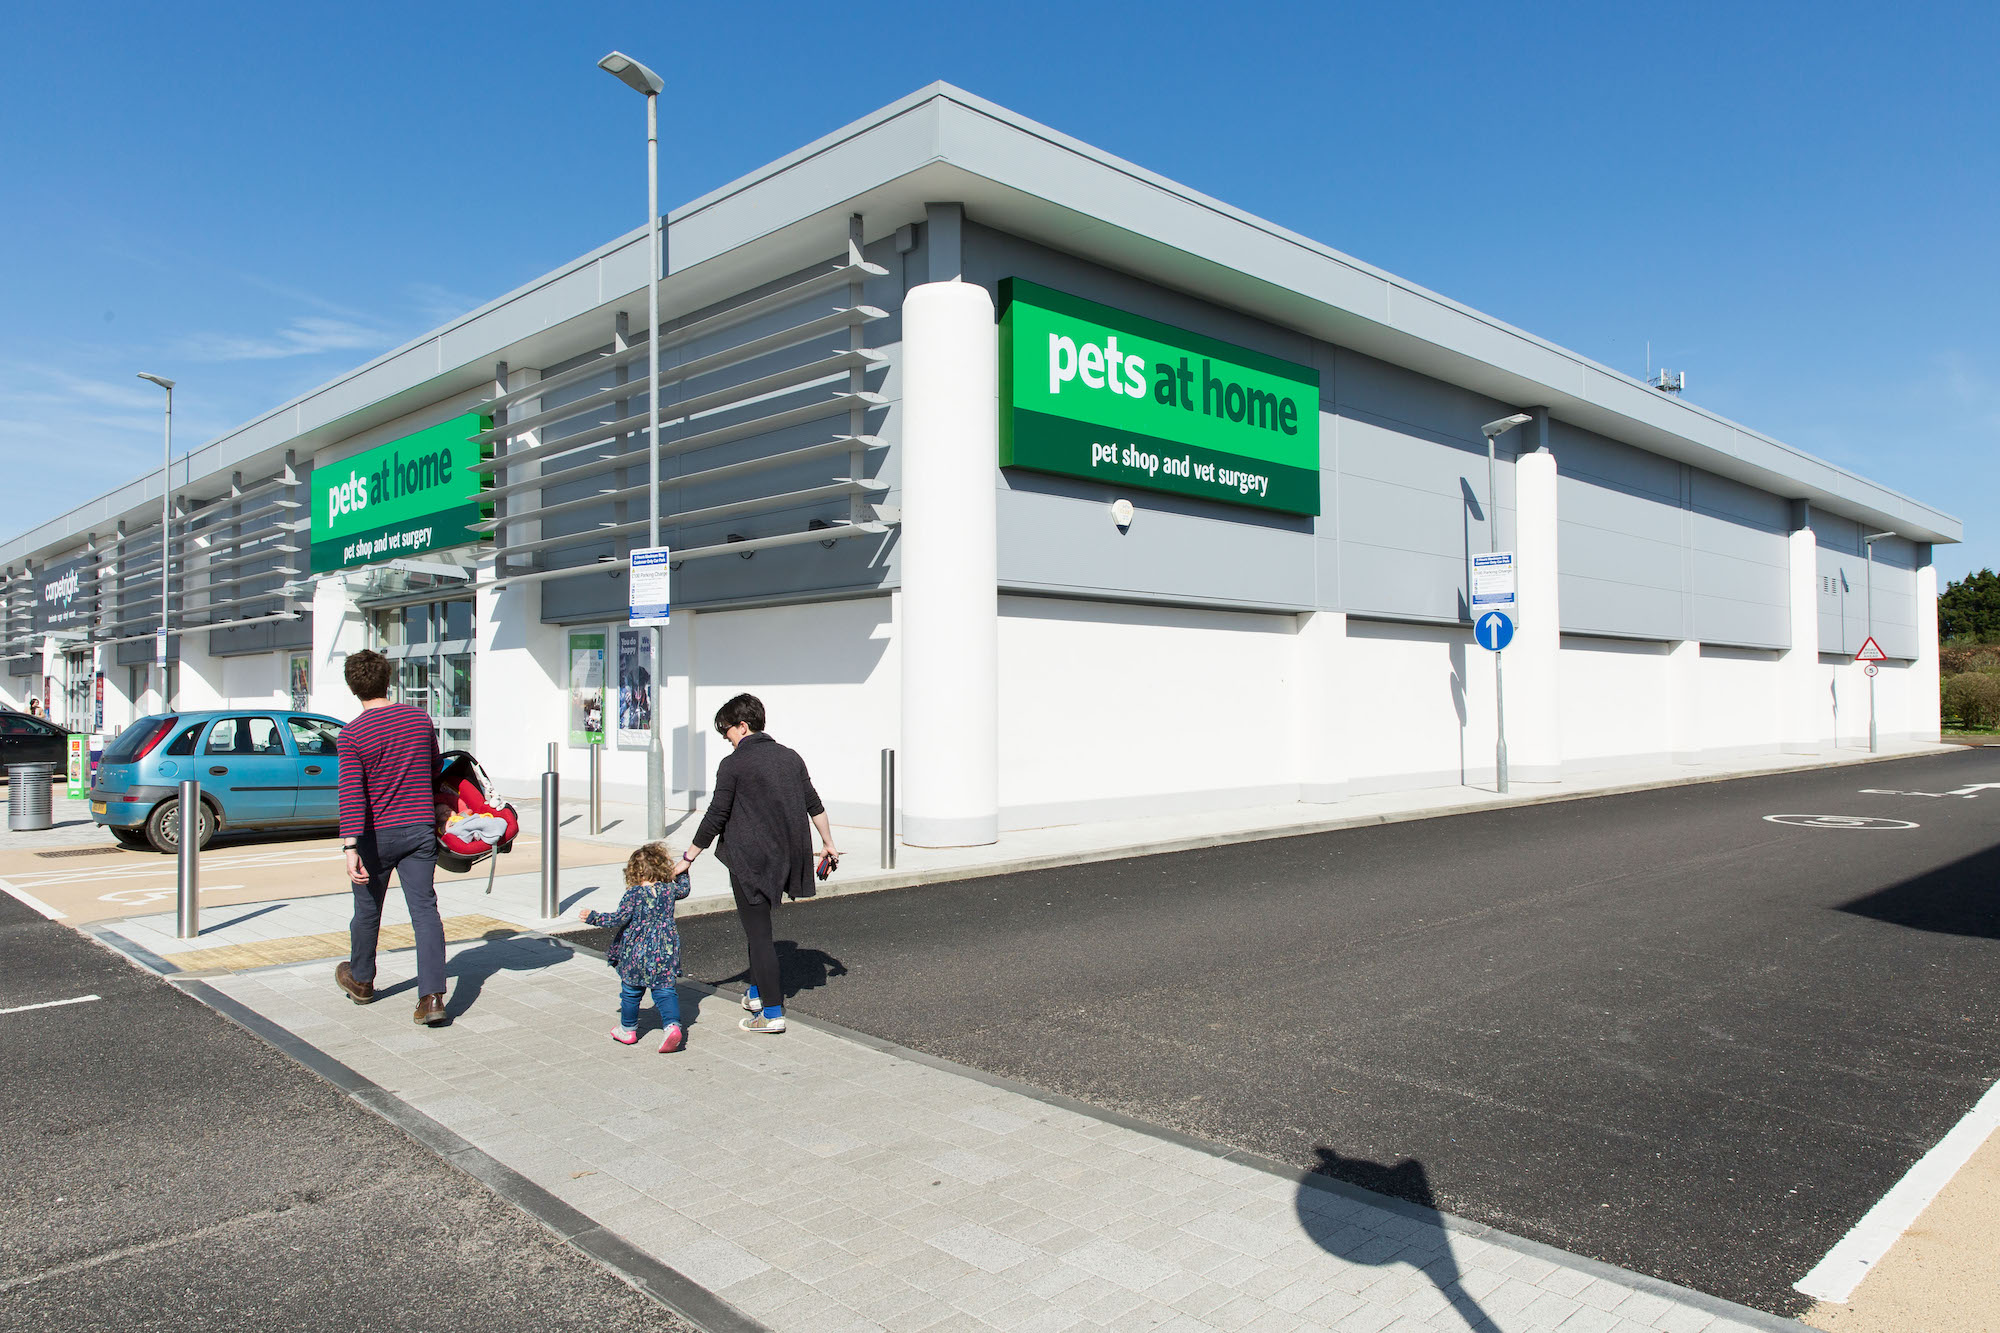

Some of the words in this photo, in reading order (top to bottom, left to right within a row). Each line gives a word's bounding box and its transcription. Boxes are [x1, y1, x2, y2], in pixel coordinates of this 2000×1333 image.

[1049, 332, 1147, 399] pets
[1154, 357, 1194, 412] at
[1202, 359, 1298, 436] home
[328, 469, 368, 529] pets
[370, 458, 390, 506] at
[393, 447, 453, 499] home
[1091, 443, 1118, 467] pet
[1122, 443, 1159, 478] shop
[1163, 455, 1190, 478] and
[1193, 462, 1215, 484] vet
[1218, 468, 1269, 497] surgery
[343, 543, 355, 565] pet
[356, 538, 373, 559] shop
[373, 532, 388, 554] and
[388, 531, 401, 550] vet
[401, 526, 433, 550] surgery
[45, 568, 78, 606] carpetright
[621, 646, 636, 655] happy
